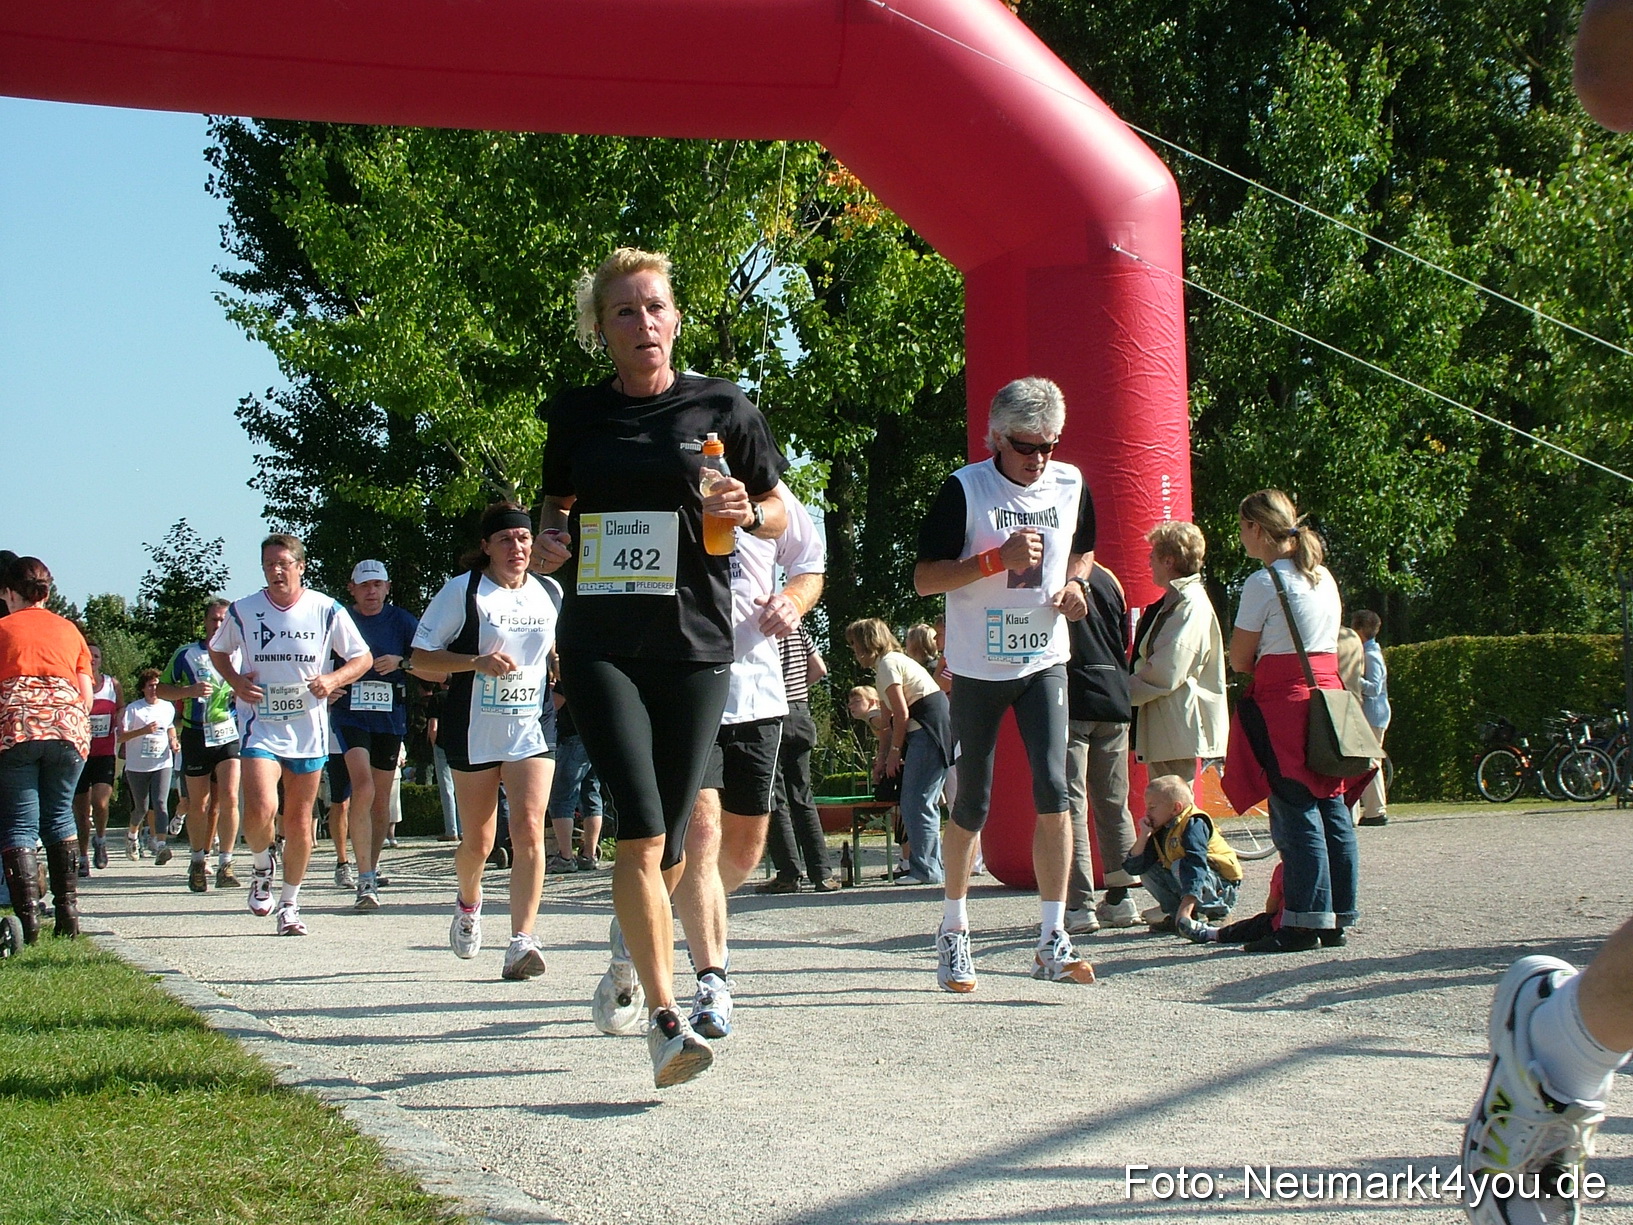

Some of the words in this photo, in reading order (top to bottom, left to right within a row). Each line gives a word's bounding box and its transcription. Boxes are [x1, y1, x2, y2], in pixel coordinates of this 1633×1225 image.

[679, 442, 701, 451] PUMA
[994, 506, 1060, 530] WETTGEWINNER
[605, 519, 650, 536] Claudia
[612, 547, 661, 571] 482
[636, 581, 674, 589] PFLEIDERER
[499, 615, 551, 625] Fischer
[1005, 613, 1029, 625] Klaus
[280, 631, 316, 640] PLAST
[1007, 632, 1049, 649] 3103
[254, 653, 292, 662] RUNNING
[294, 654, 316, 663] TEAM
[269, 686, 300, 695] Wolfgang
[363, 691, 390, 702] 3133
[500, 688, 536, 702] 2437
[272, 699, 304, 711] 3063
[214, 726, 235, 738] 2979
